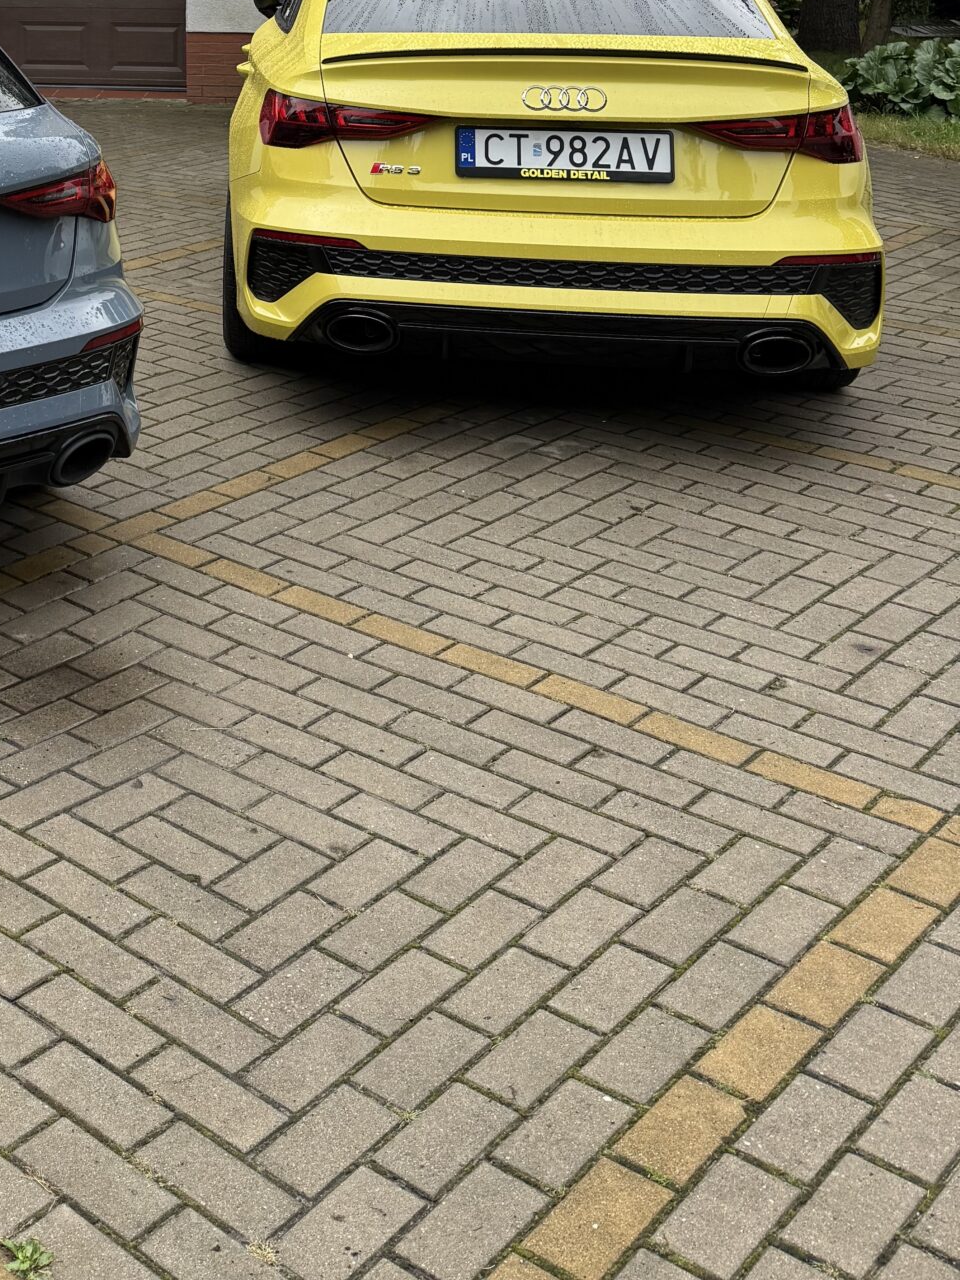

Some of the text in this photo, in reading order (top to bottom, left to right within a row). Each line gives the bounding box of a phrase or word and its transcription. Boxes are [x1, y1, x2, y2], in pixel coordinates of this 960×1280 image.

[461, 133, 661, 171] PL CT 982AV
[520, 168, 610, 180] GOLDEN DETAIL
